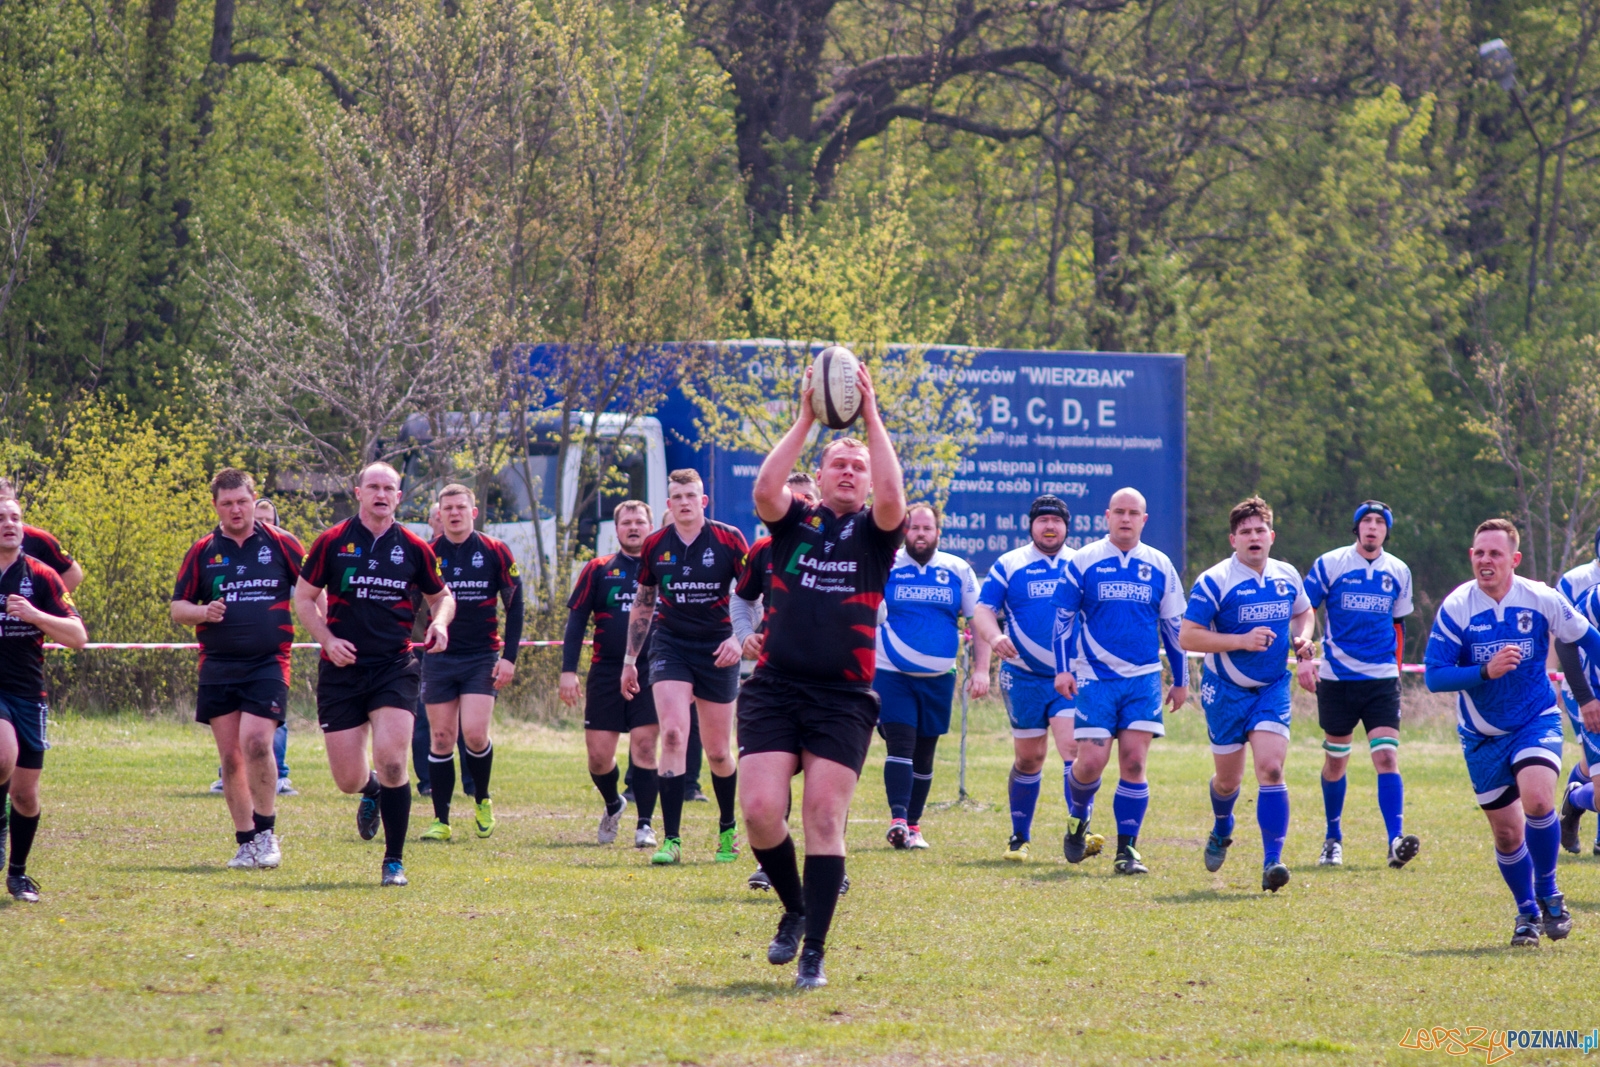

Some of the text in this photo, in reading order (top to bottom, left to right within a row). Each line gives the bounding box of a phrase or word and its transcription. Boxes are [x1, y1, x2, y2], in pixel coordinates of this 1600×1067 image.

[1020, 366, 1134, 388] "WIERZBAK"
[991, 397, 1018, 429] B,
[1026, 397, 1053, 430] C,
[1062, 398, 1089, 430] D,
[1098, 400, 1117, 427] E
[977, 459, 1036, 476] wstępna
[1046, 460, 1113, 476] okresowa
[997, 478, 1032, 493] osób
[1042, 481, 1089, 498] rzeczy.
[970, 512, 986, 529] 21
[996, 513, 1018, 530] tel.
[938, 534, 985, 554] skiego
[987, 535, 1008, 551] 6/8
[219, 579, 279, 591] LAFARGE
[348, 575, 407, 589] LAFARGE
[666, 582, 720, 590] LAFARGE
[1100, 583, 1150, 593] EXTREME
[897, 586, 951, 594] EXTREME
[1344, 594, 1391, 604] EXTREME
[1241, 602, 1288, 613] EXTREME
